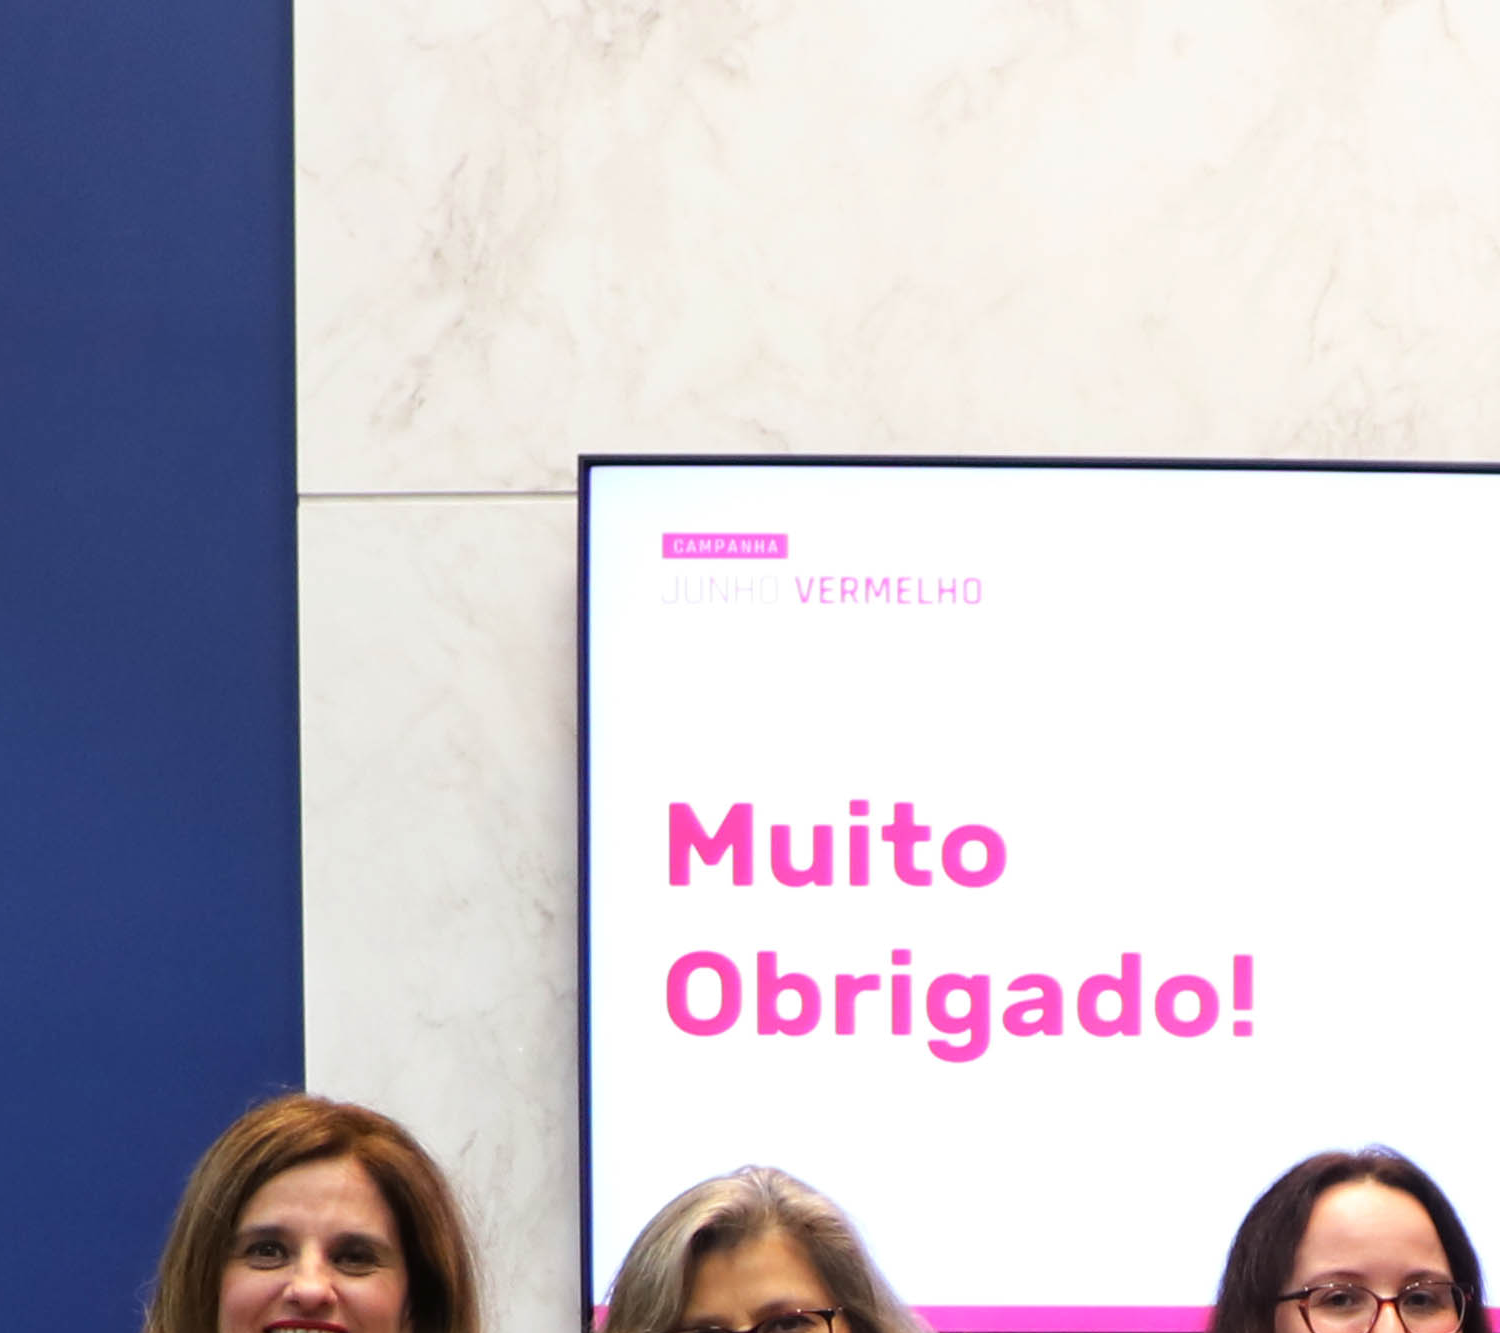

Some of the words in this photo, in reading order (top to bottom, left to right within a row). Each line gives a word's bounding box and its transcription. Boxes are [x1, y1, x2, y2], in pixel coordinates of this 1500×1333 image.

[672, 537, 780, 554] CAMPANHA
[795, 575, 982, 605] VERMELHO
[668, 798, 1007, 888] Muito
[665, 948, 1255, 1063] Obrigado!
